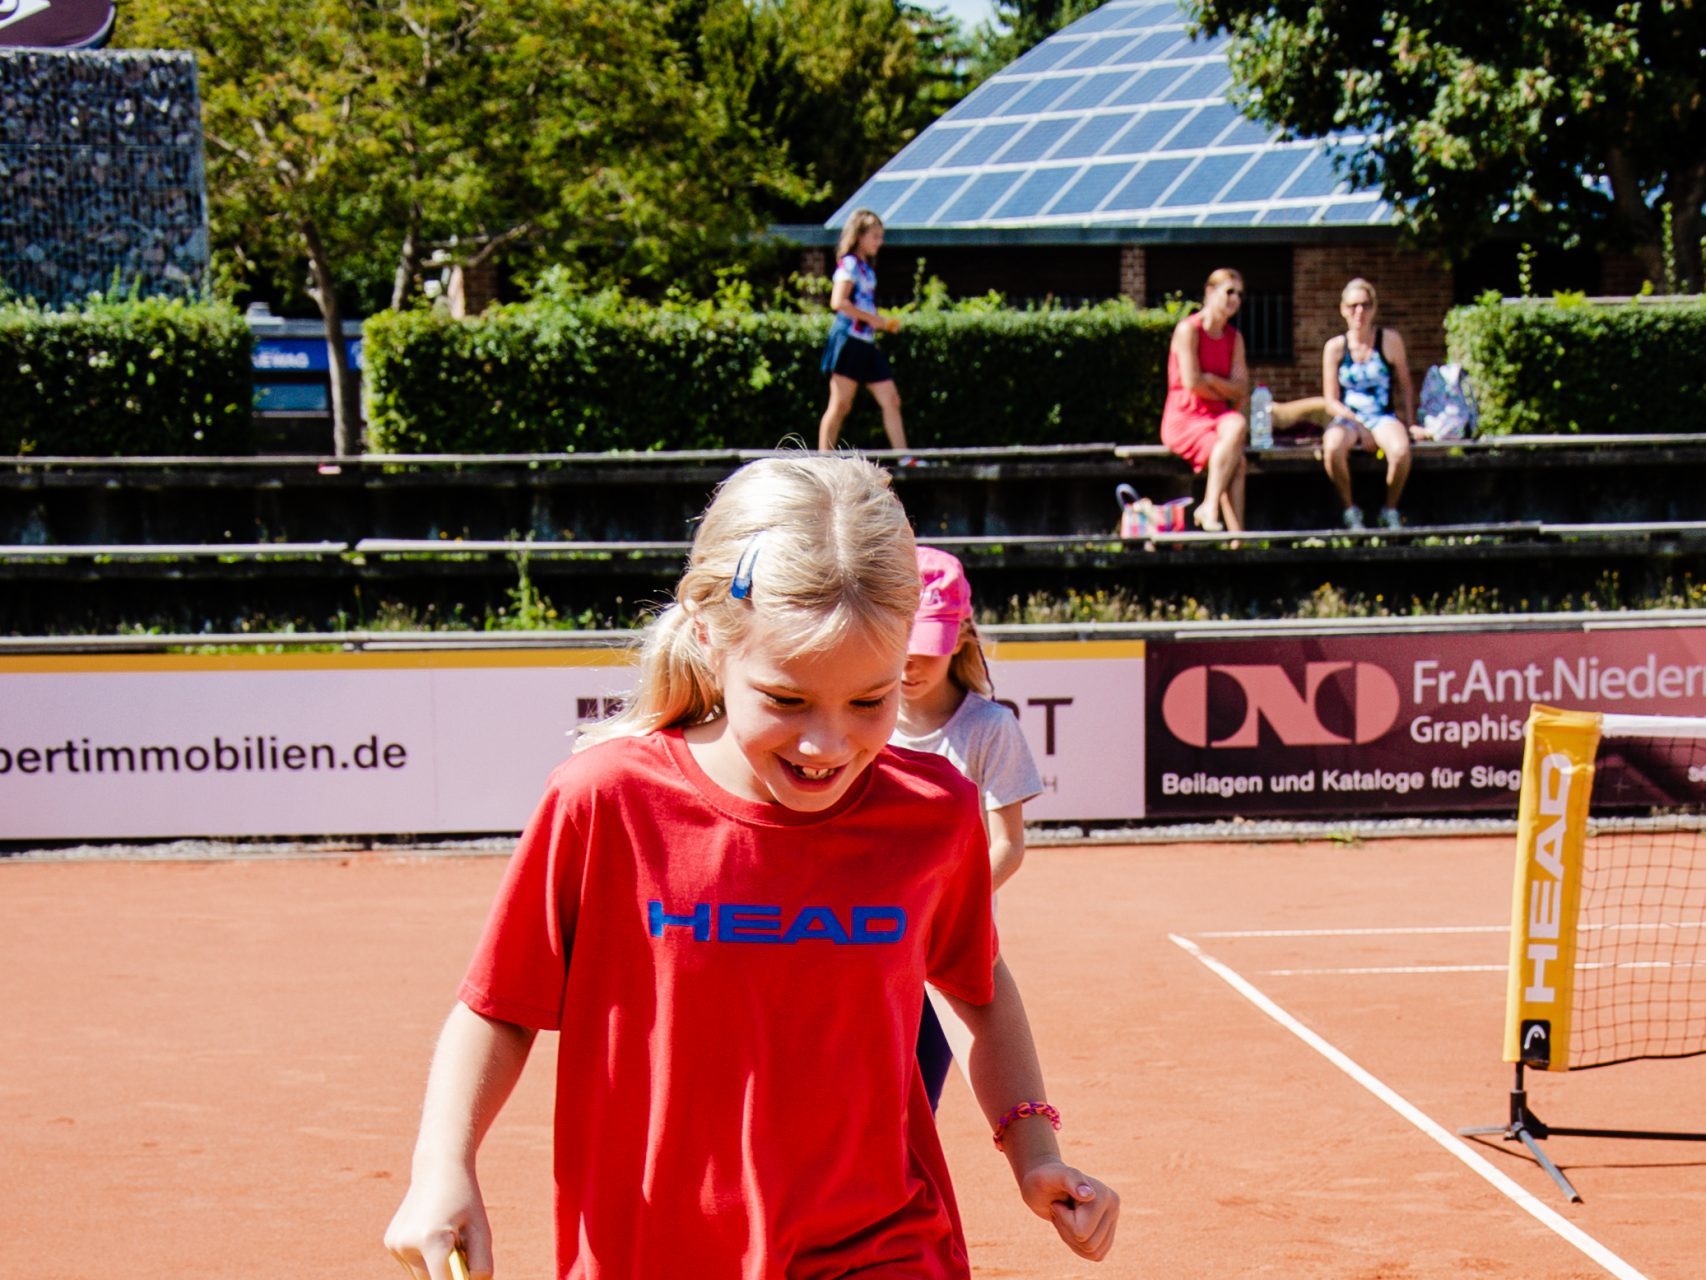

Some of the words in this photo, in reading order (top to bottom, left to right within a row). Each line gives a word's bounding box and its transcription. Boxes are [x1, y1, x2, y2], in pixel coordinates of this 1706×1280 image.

[1162, 773, 1264, 798] Beilagen
[1270, 770, 1315, 793] und
[1322, 768, 1425, 795] Kataloge
[1431, 766, 1464, 789] für
[1525, 752, 1573, 1003] HEAD
[648, 900, 907, 945] HEAD
